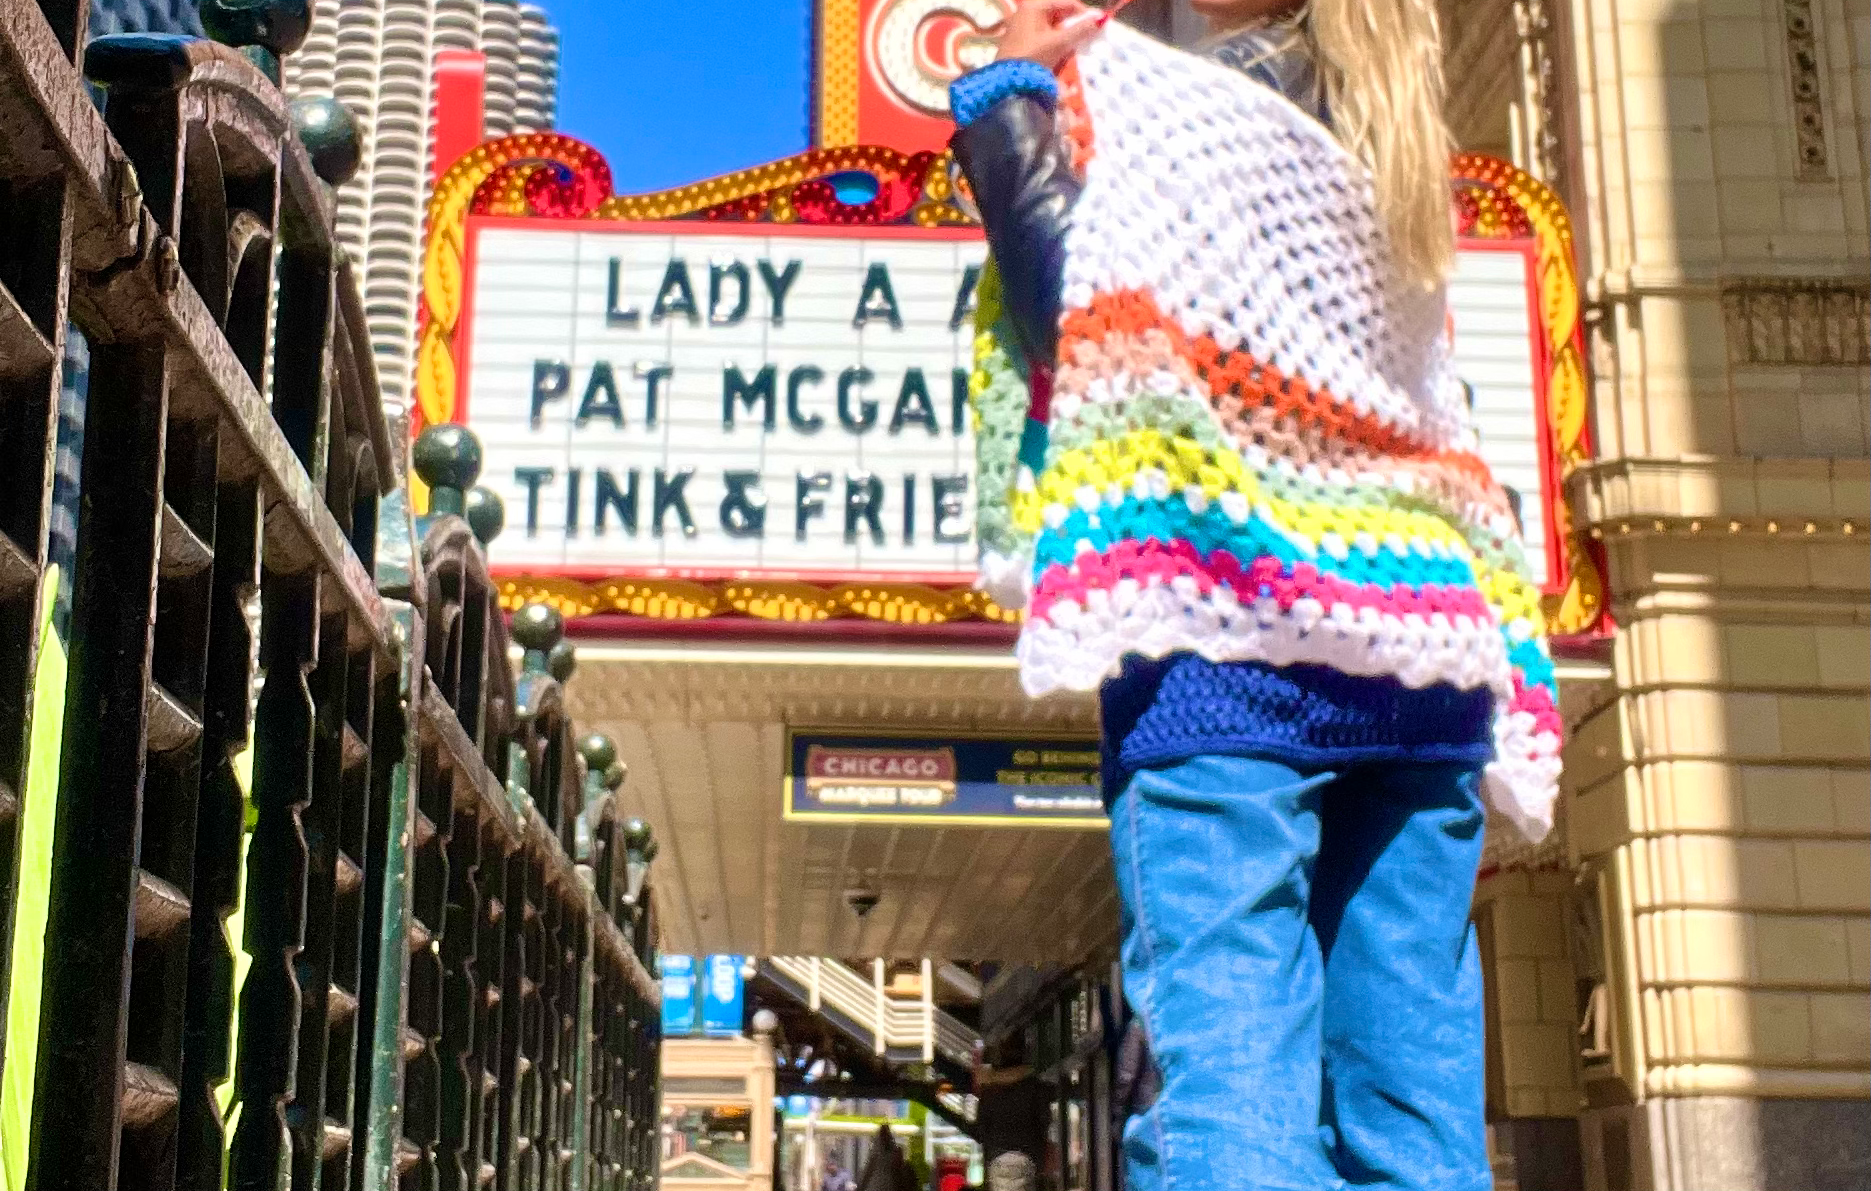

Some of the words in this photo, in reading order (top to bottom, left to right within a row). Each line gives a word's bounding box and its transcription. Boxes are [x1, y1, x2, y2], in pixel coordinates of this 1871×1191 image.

[606, 256, 803, 329] LADY
[852, 262, 903, 330] A
[531, 359, 673, 429] PAT
[823, 757, 940, 776] CHICAGO
